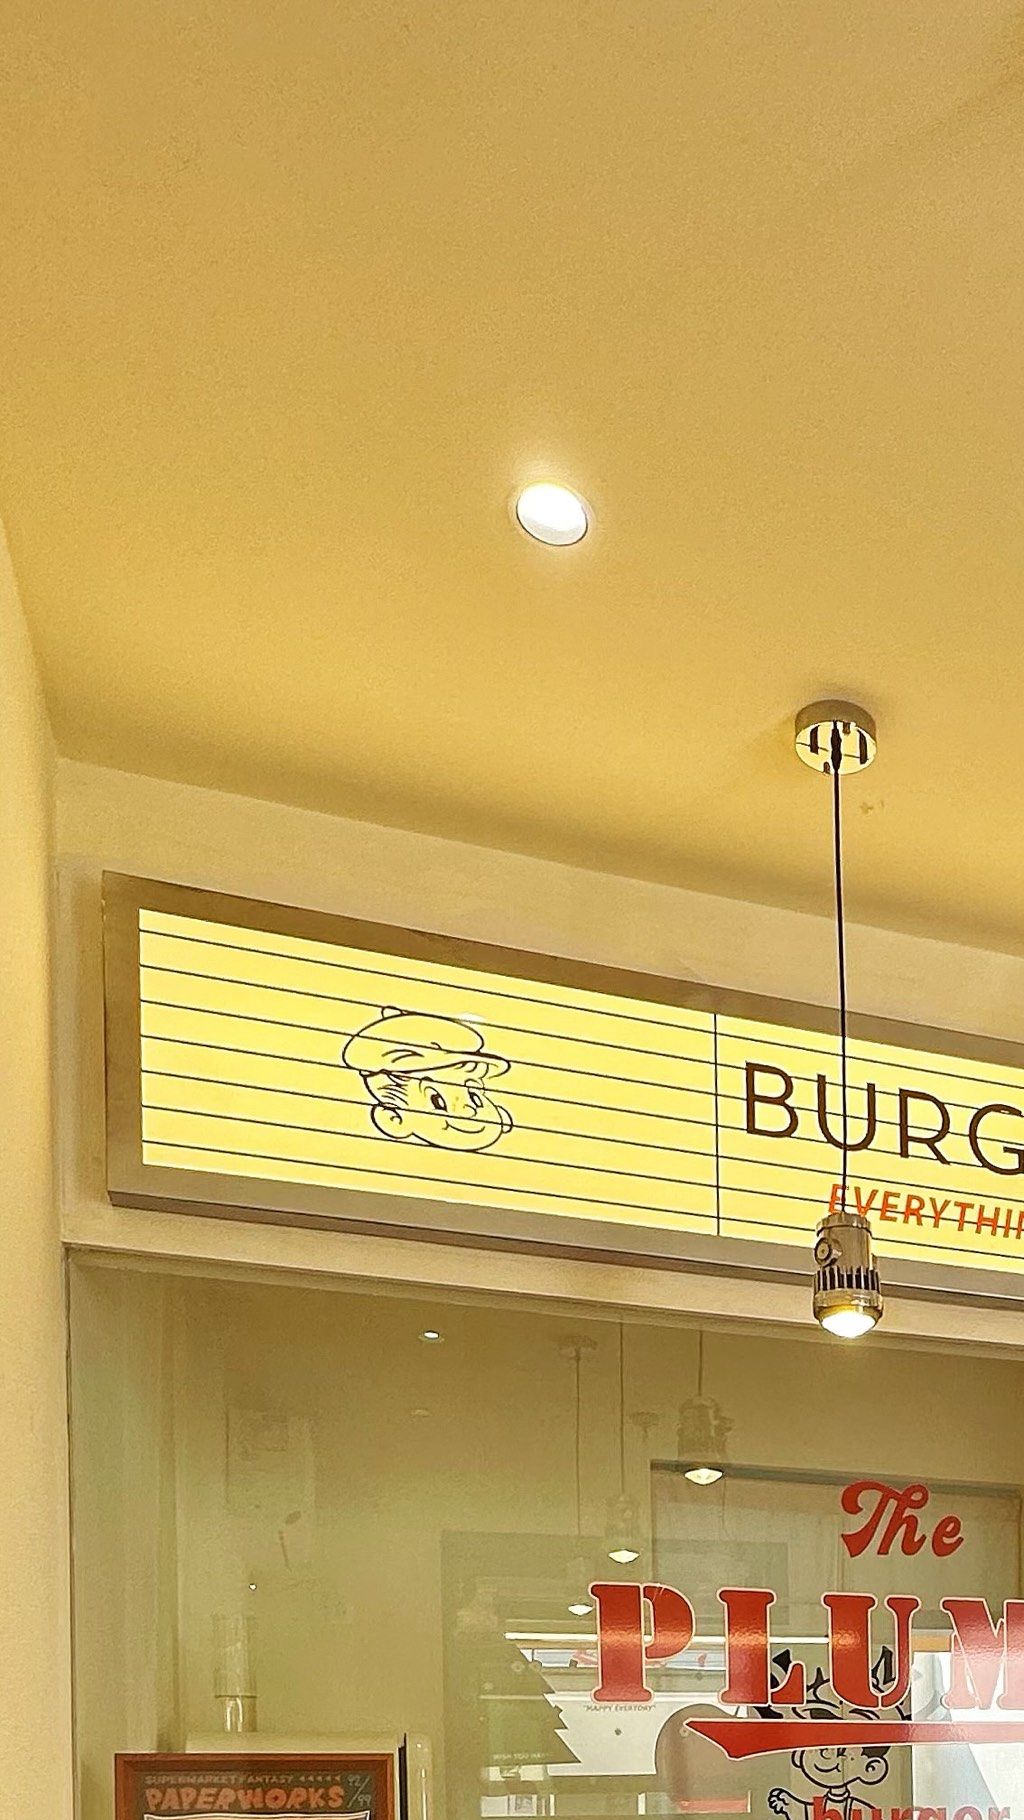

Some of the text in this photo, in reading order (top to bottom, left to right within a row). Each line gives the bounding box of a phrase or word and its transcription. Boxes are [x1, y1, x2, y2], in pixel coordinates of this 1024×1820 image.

[840, 1479, 964, 1558] The
[144, 1774, 237, 1785] SUPERMARKET
[145, 1785, 345, 1811] PAPERWORKS
